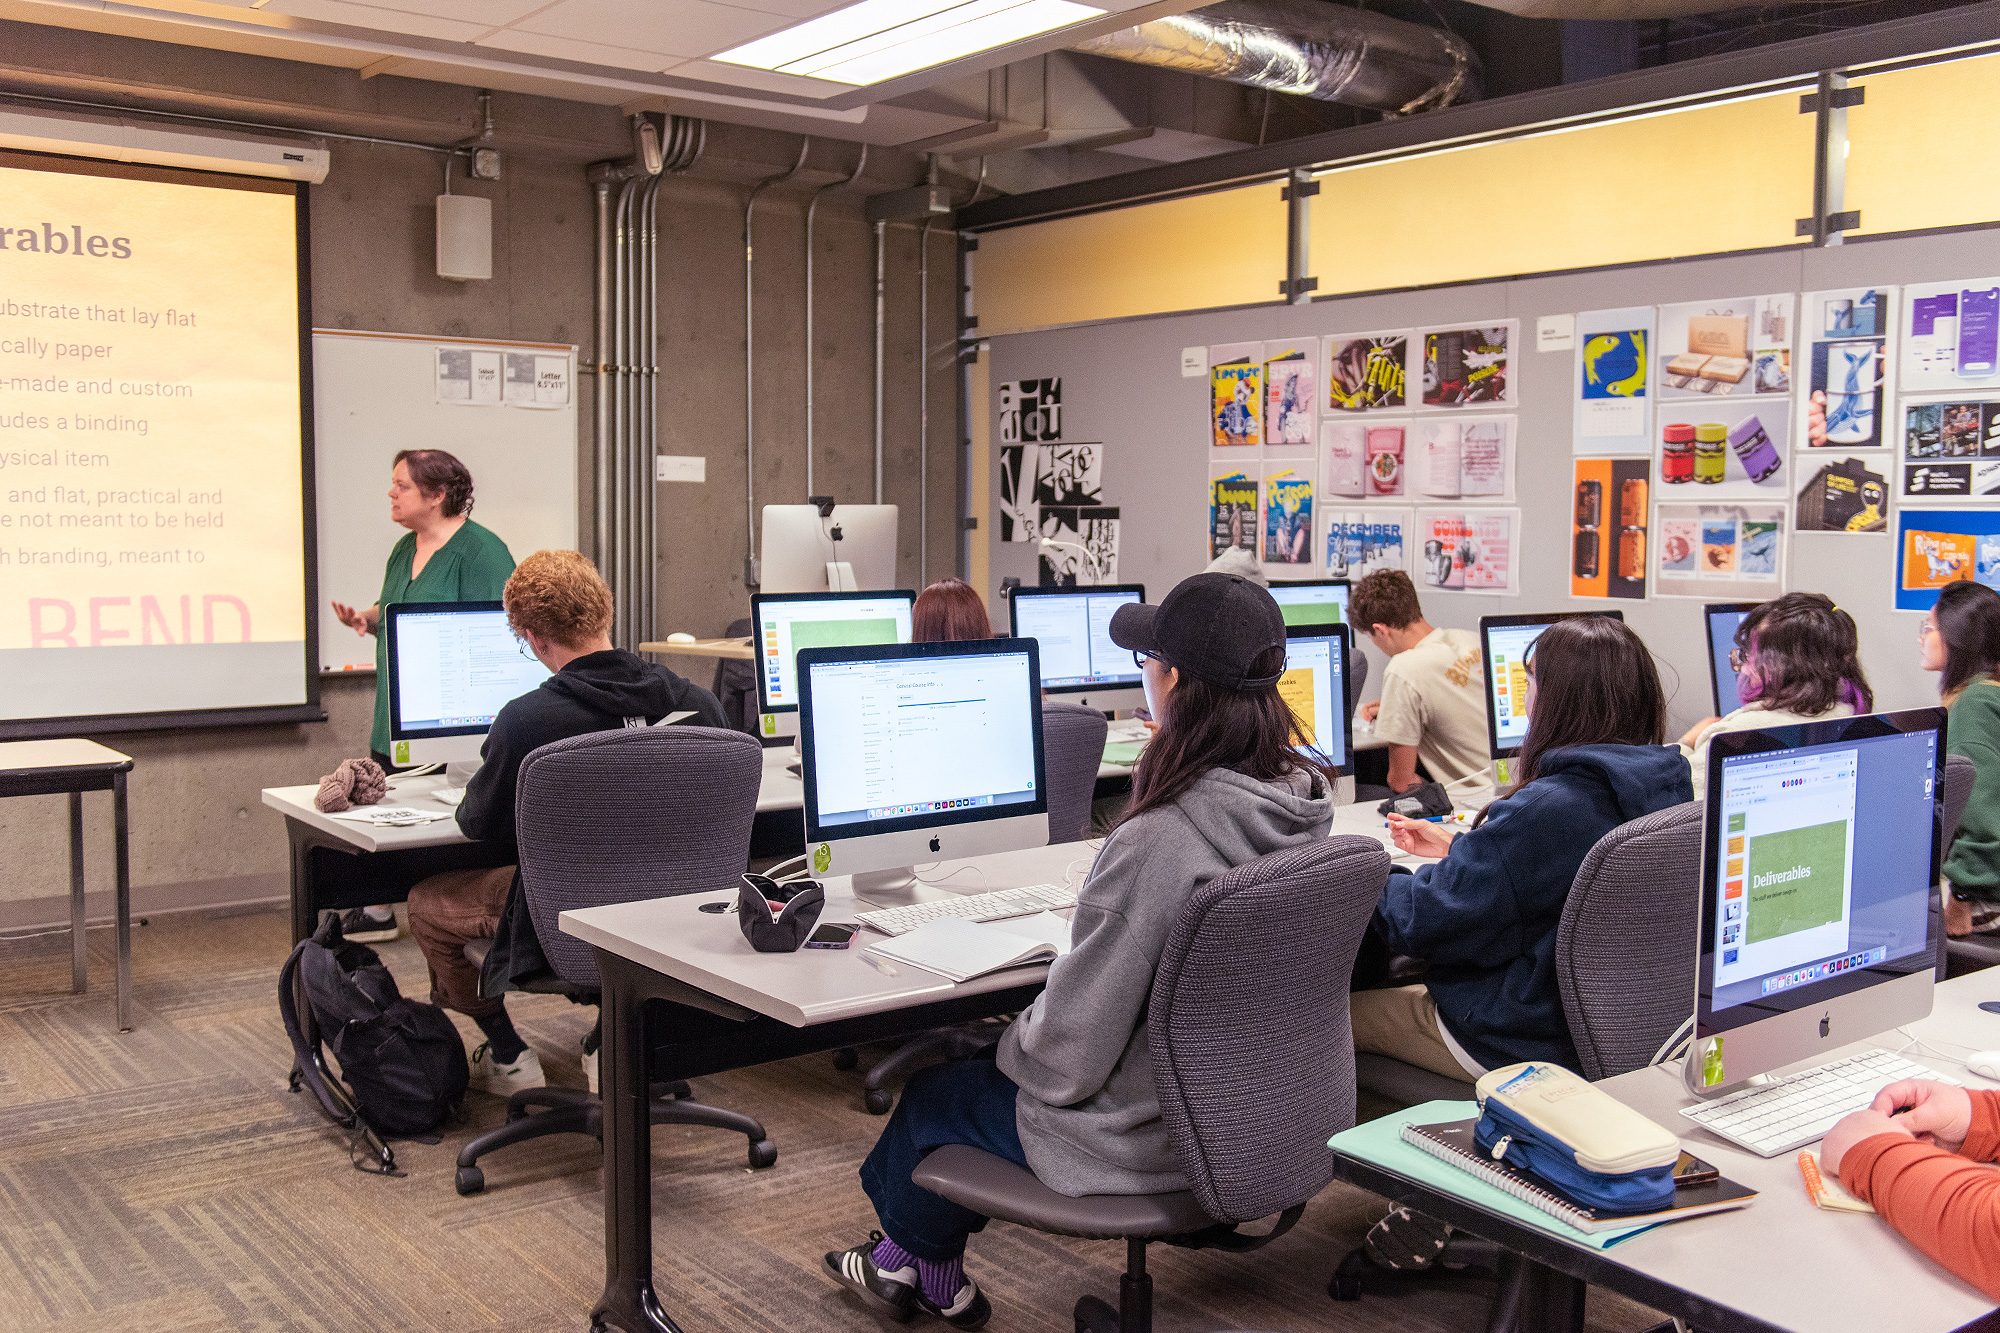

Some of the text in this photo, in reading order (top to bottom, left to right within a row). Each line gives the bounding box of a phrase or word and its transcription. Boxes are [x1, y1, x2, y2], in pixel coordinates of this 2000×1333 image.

[0, 223, 132, 259] rables
[86, 304, 125, 322] that
[132, 307, 159, 328] lay
[166, 309, 197, 327] flat
[1, 337, 112, 361] cally paper
[541, 371, 561, 380] Letter
[0, 376, 192, 397] -made and custom
[0, 412, 148, 436] udes a binding
[65, 450, 109, 467] item
[9, 486, 222, 507] and flat, practical and
[20, 512, 52, 527] not
[59, 512, 123, 527] meant
[130, 512, 148, 528] to
[155, 511, 178, 528] be
[184, 511, 224, 528] held
[1332, 523, 1400, 536] DECEMBER
[19, 547, 112, 567] branding,
[119, 549, 181, 564] meant
[187, 548, 205, 563] to
[819, 845, 828, 856] 13
[1753, 865, 1811, 888] Deliverables
